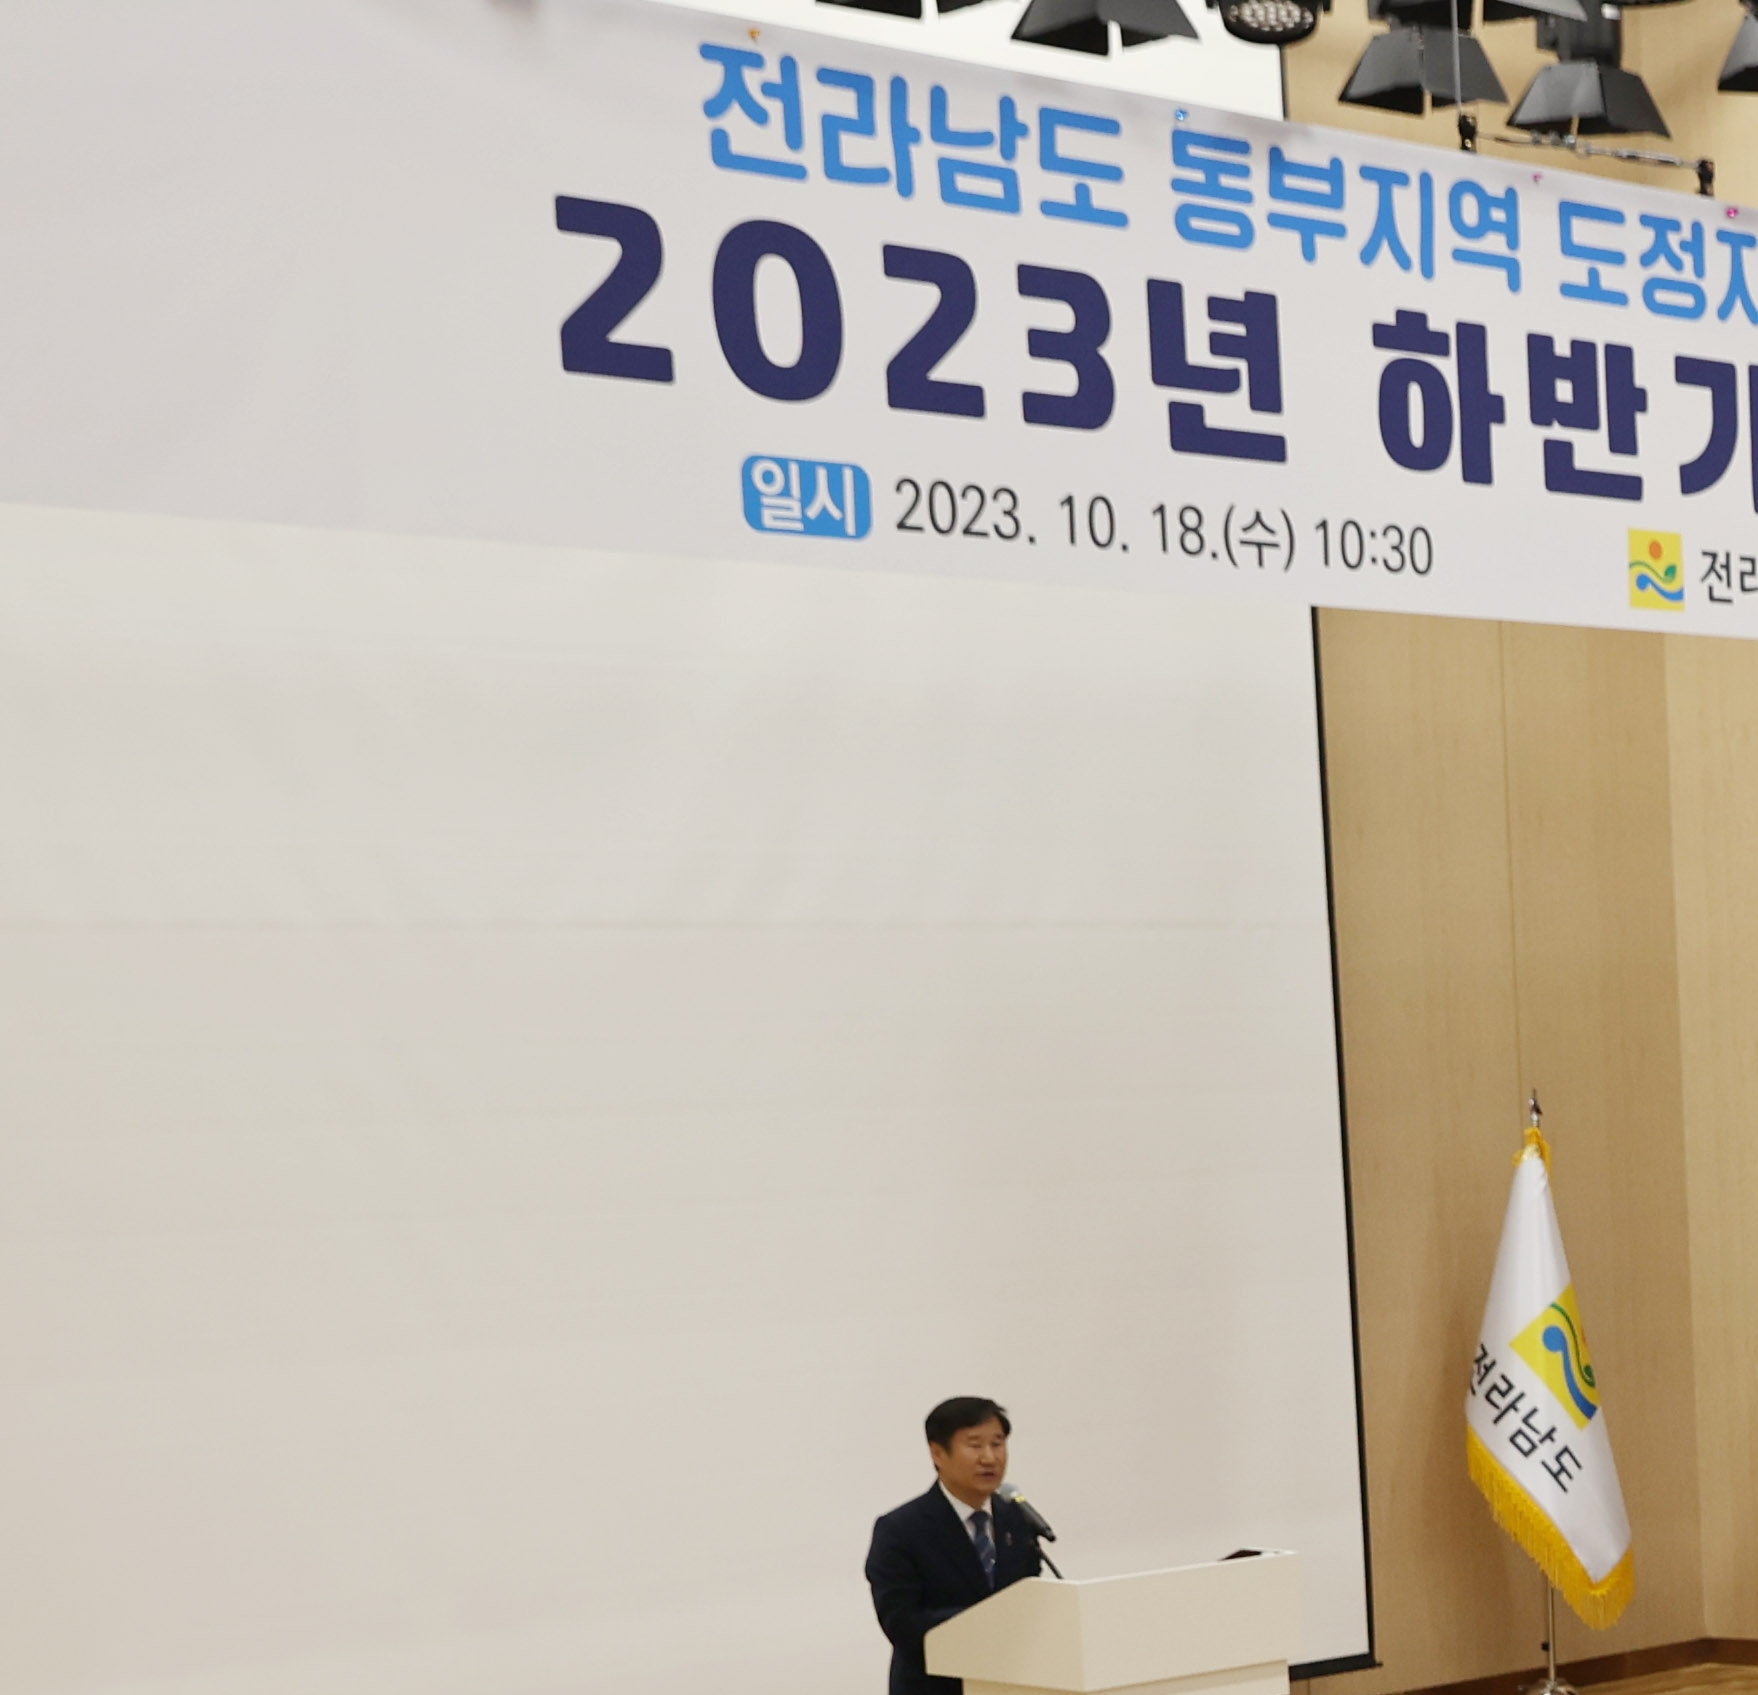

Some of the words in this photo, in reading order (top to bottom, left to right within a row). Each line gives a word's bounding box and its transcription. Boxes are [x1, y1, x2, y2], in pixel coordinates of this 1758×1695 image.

[699, 43, 1129, 229] 전라남도
[1170, 129, 1522, 291] 동부지역
[555, 195, 1286, 462] 2023년
[750, 458, 859, 536] 일시
[895, 478, 1037, 545] 2023.
[1059, 494, 1128, 552] 10.
[1315, 519, 1434, 575] 10:30
